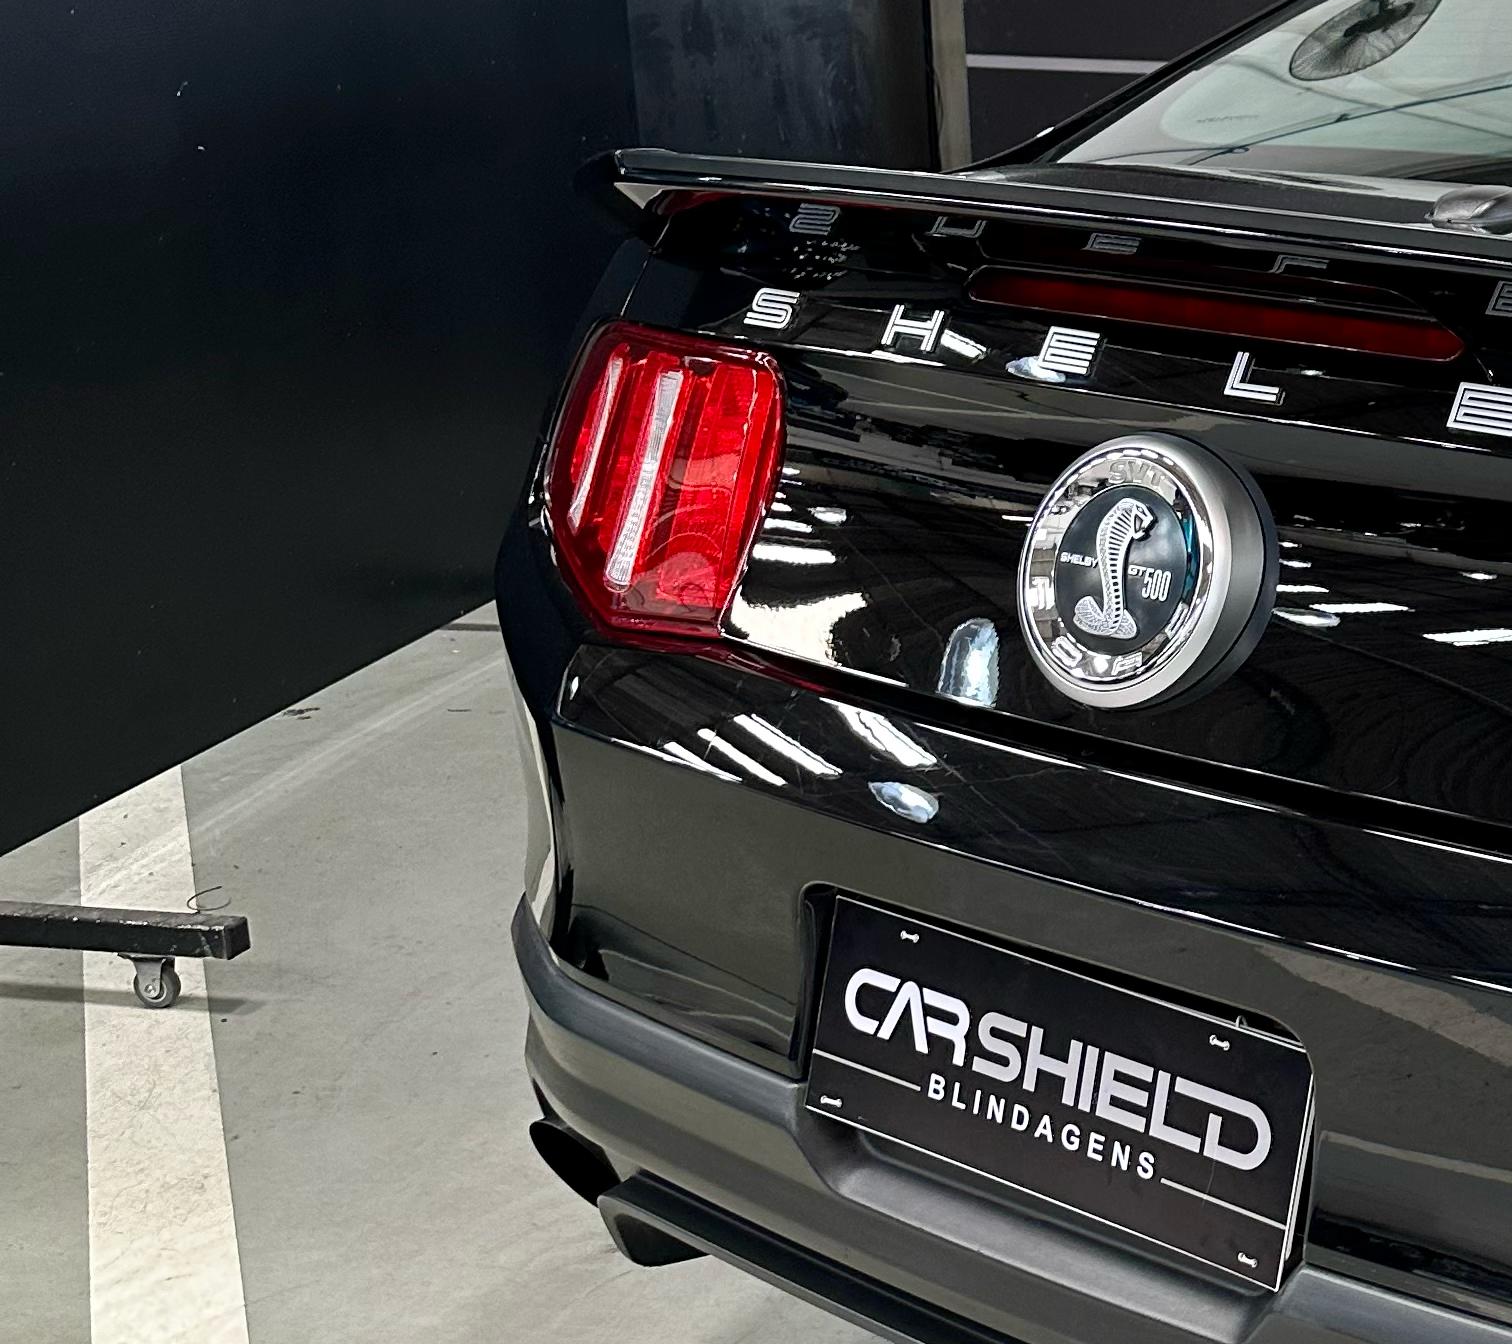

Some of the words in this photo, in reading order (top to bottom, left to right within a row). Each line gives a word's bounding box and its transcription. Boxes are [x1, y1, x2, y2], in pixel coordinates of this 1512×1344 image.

[1107, 459, 1168, 486] SVT
[1060, 551, 1099, 568] SHELBY
[927, 1072, 1156, 1180] BLINDAGENS
